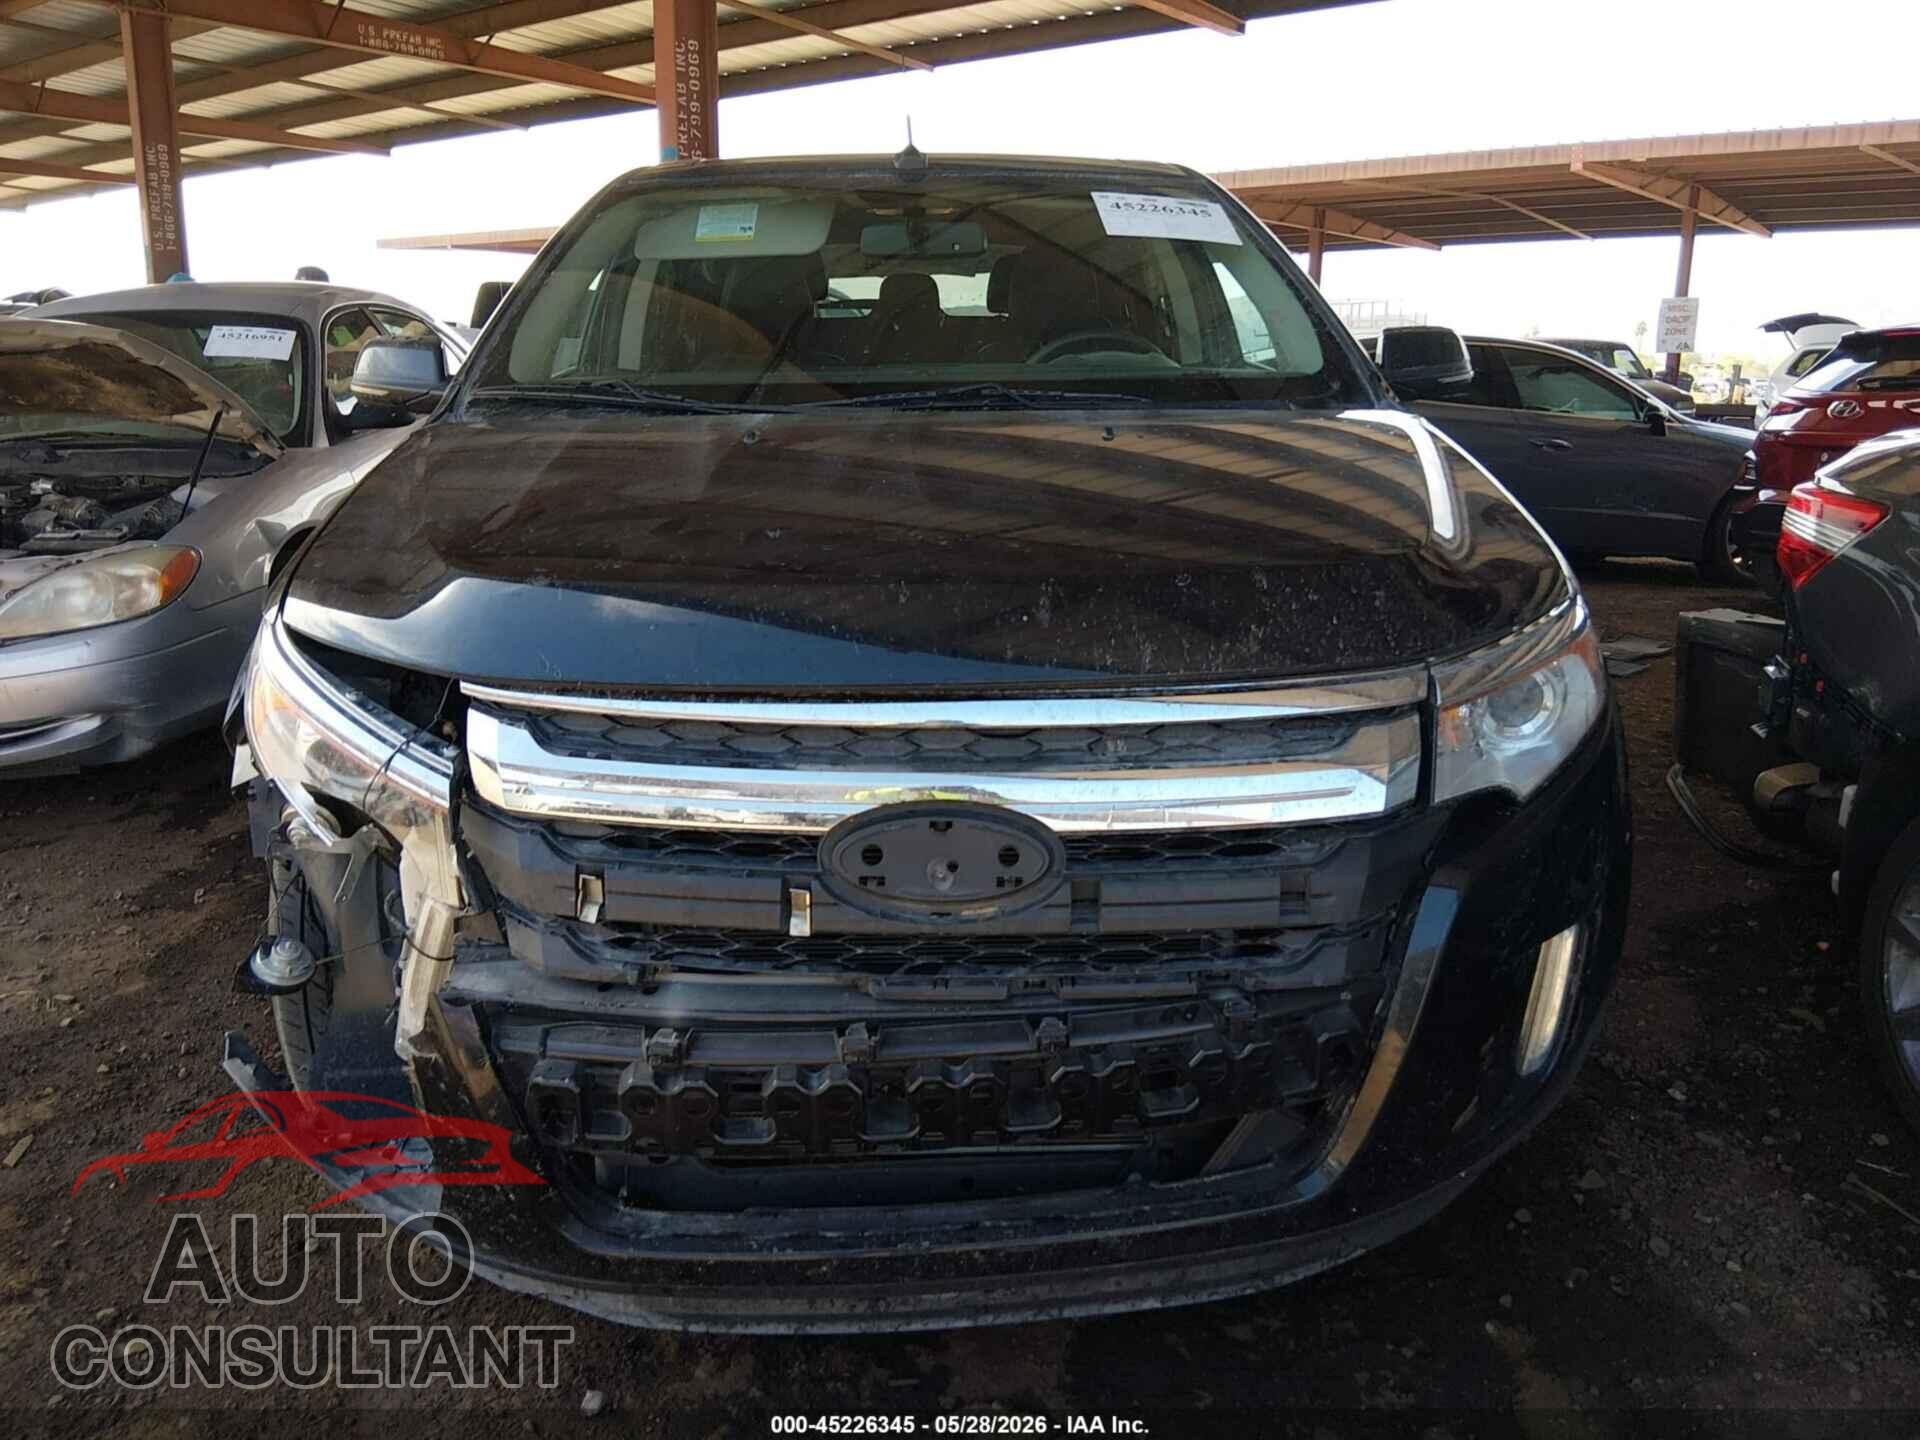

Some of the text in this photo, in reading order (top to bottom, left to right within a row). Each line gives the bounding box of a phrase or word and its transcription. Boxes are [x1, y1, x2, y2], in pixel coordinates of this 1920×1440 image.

[382, 27, 422, 45] PREFAB
[675, 36, 689, 157] PREFAB INC.
[148, 172, 162, 222] PREFAB
[1110, 201, 1213, 218] 45226345
[1664, 327, 1688, 336] ZONE
